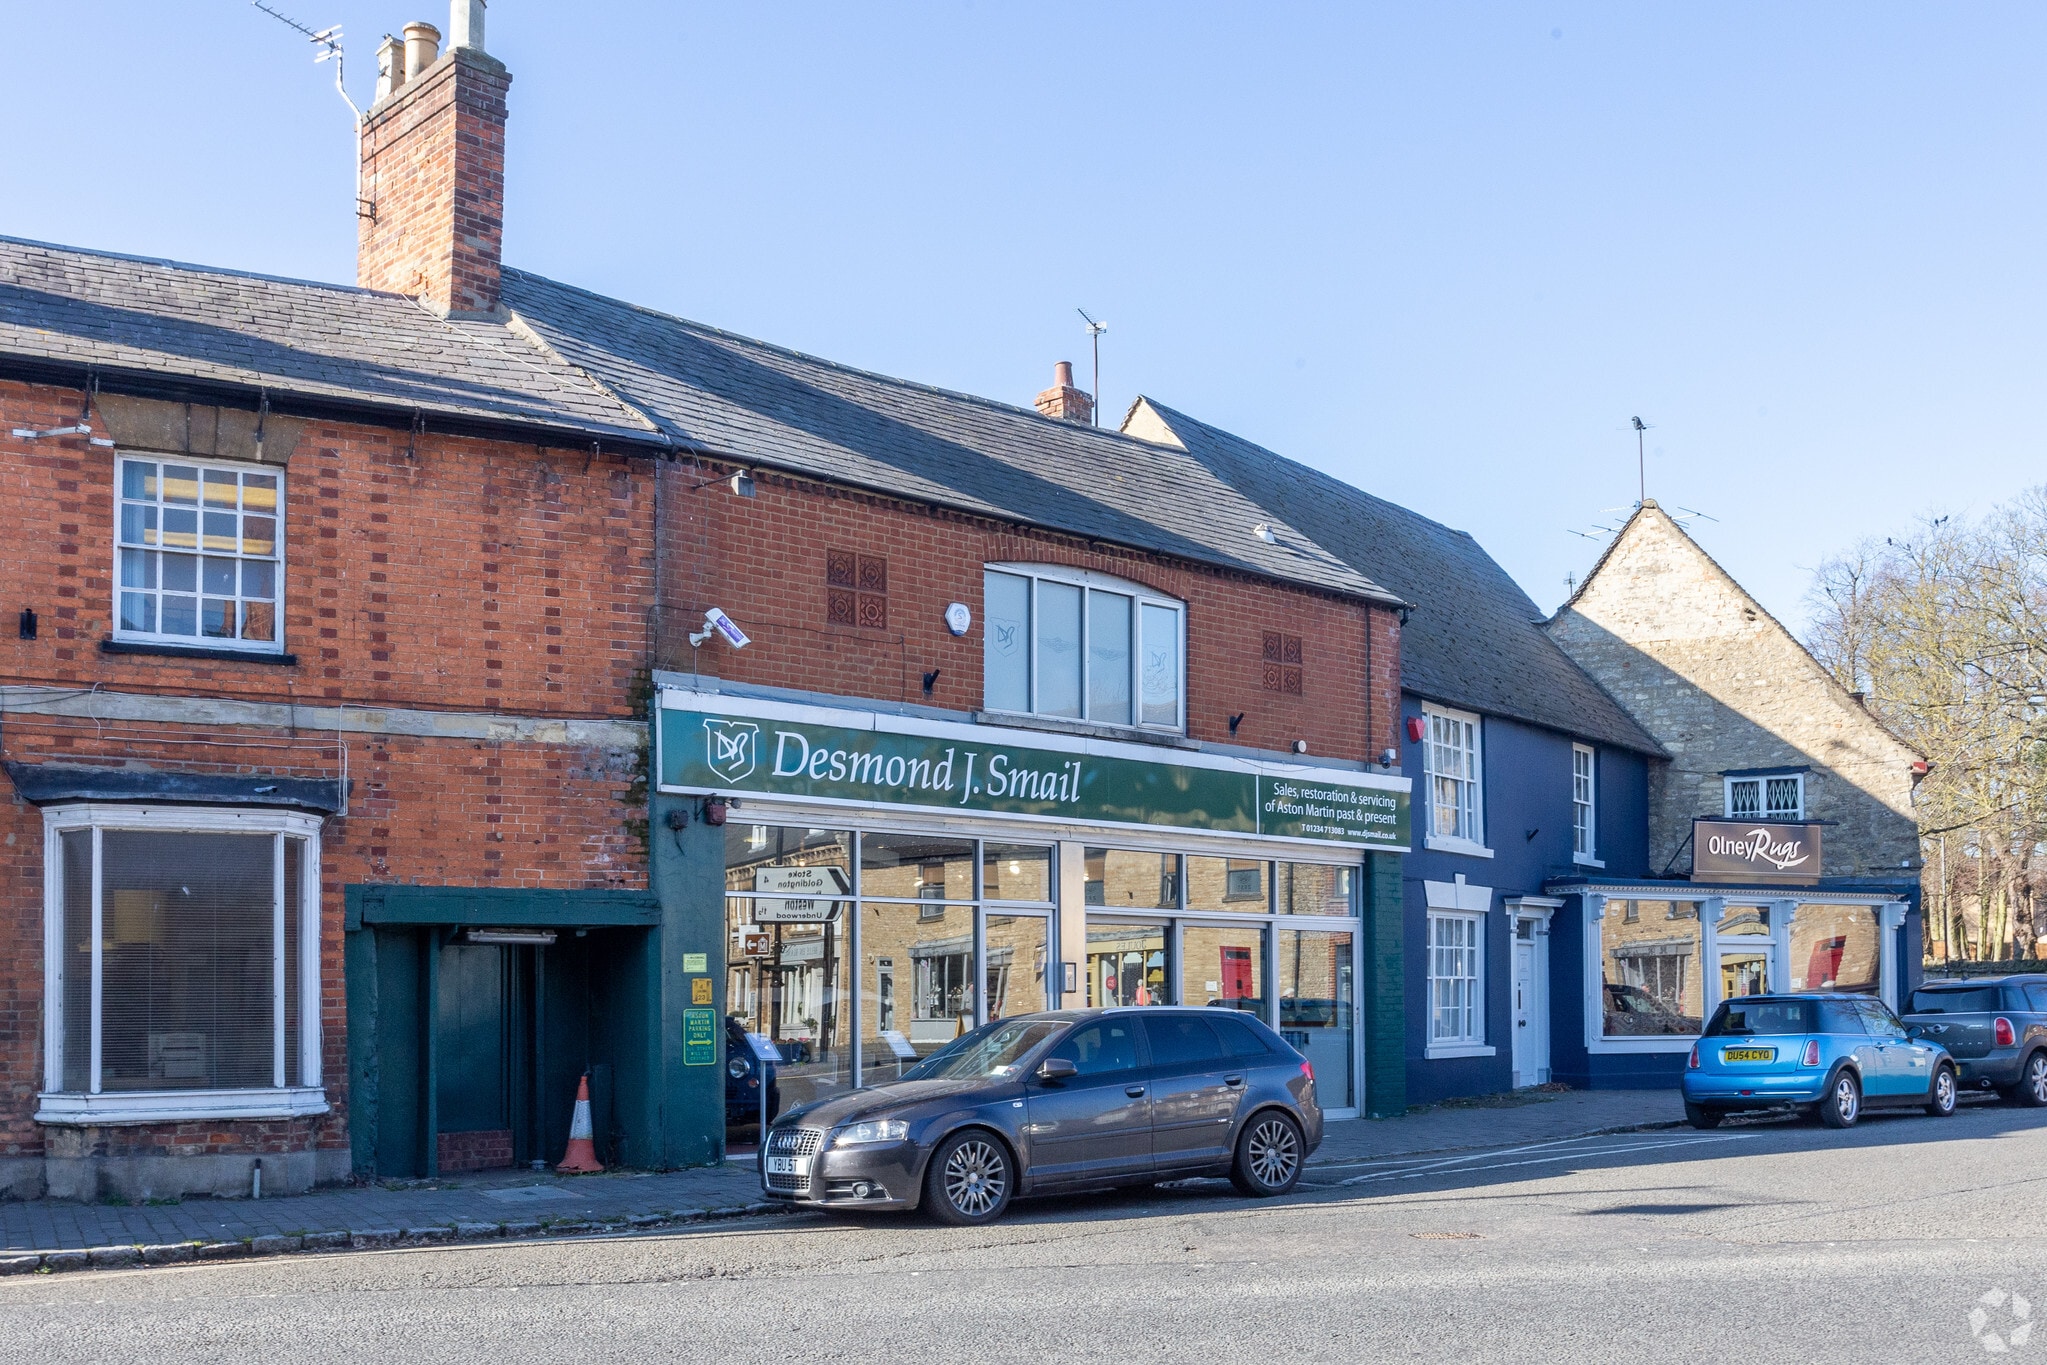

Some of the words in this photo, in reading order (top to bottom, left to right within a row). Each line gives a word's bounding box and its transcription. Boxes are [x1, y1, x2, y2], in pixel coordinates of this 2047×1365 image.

[772, 731, 955, 791] Desmond
[959, 752, 979, 804] J.
[986, 754, 1081, 803] Smail
[1273, 782, 1299, 799] Sales,
[1301, 788, 1349, 803] restoration
[1350, 791, 1358, 804] &
[1358, 794, 1396, 811] servicing
[1265, 798, 1276, 812] of
[1277, 800, 1304, 815] Aston
[1305, 803, 1335, 818] Martin
[1336, 809, 1355, 822] past
[1356, 808, 1363, 821] &
[1364, 812, 1397, 825] present
[1305, 824, 1324, 833] 01234
[1347, 829, 1397, 840] www.djsmail.co.uk
[1708, 835, 1754, 860] Olney
[1745, 828, 1810, 870] Rugs
[1727, 1051, 1750, 1060] DU54
